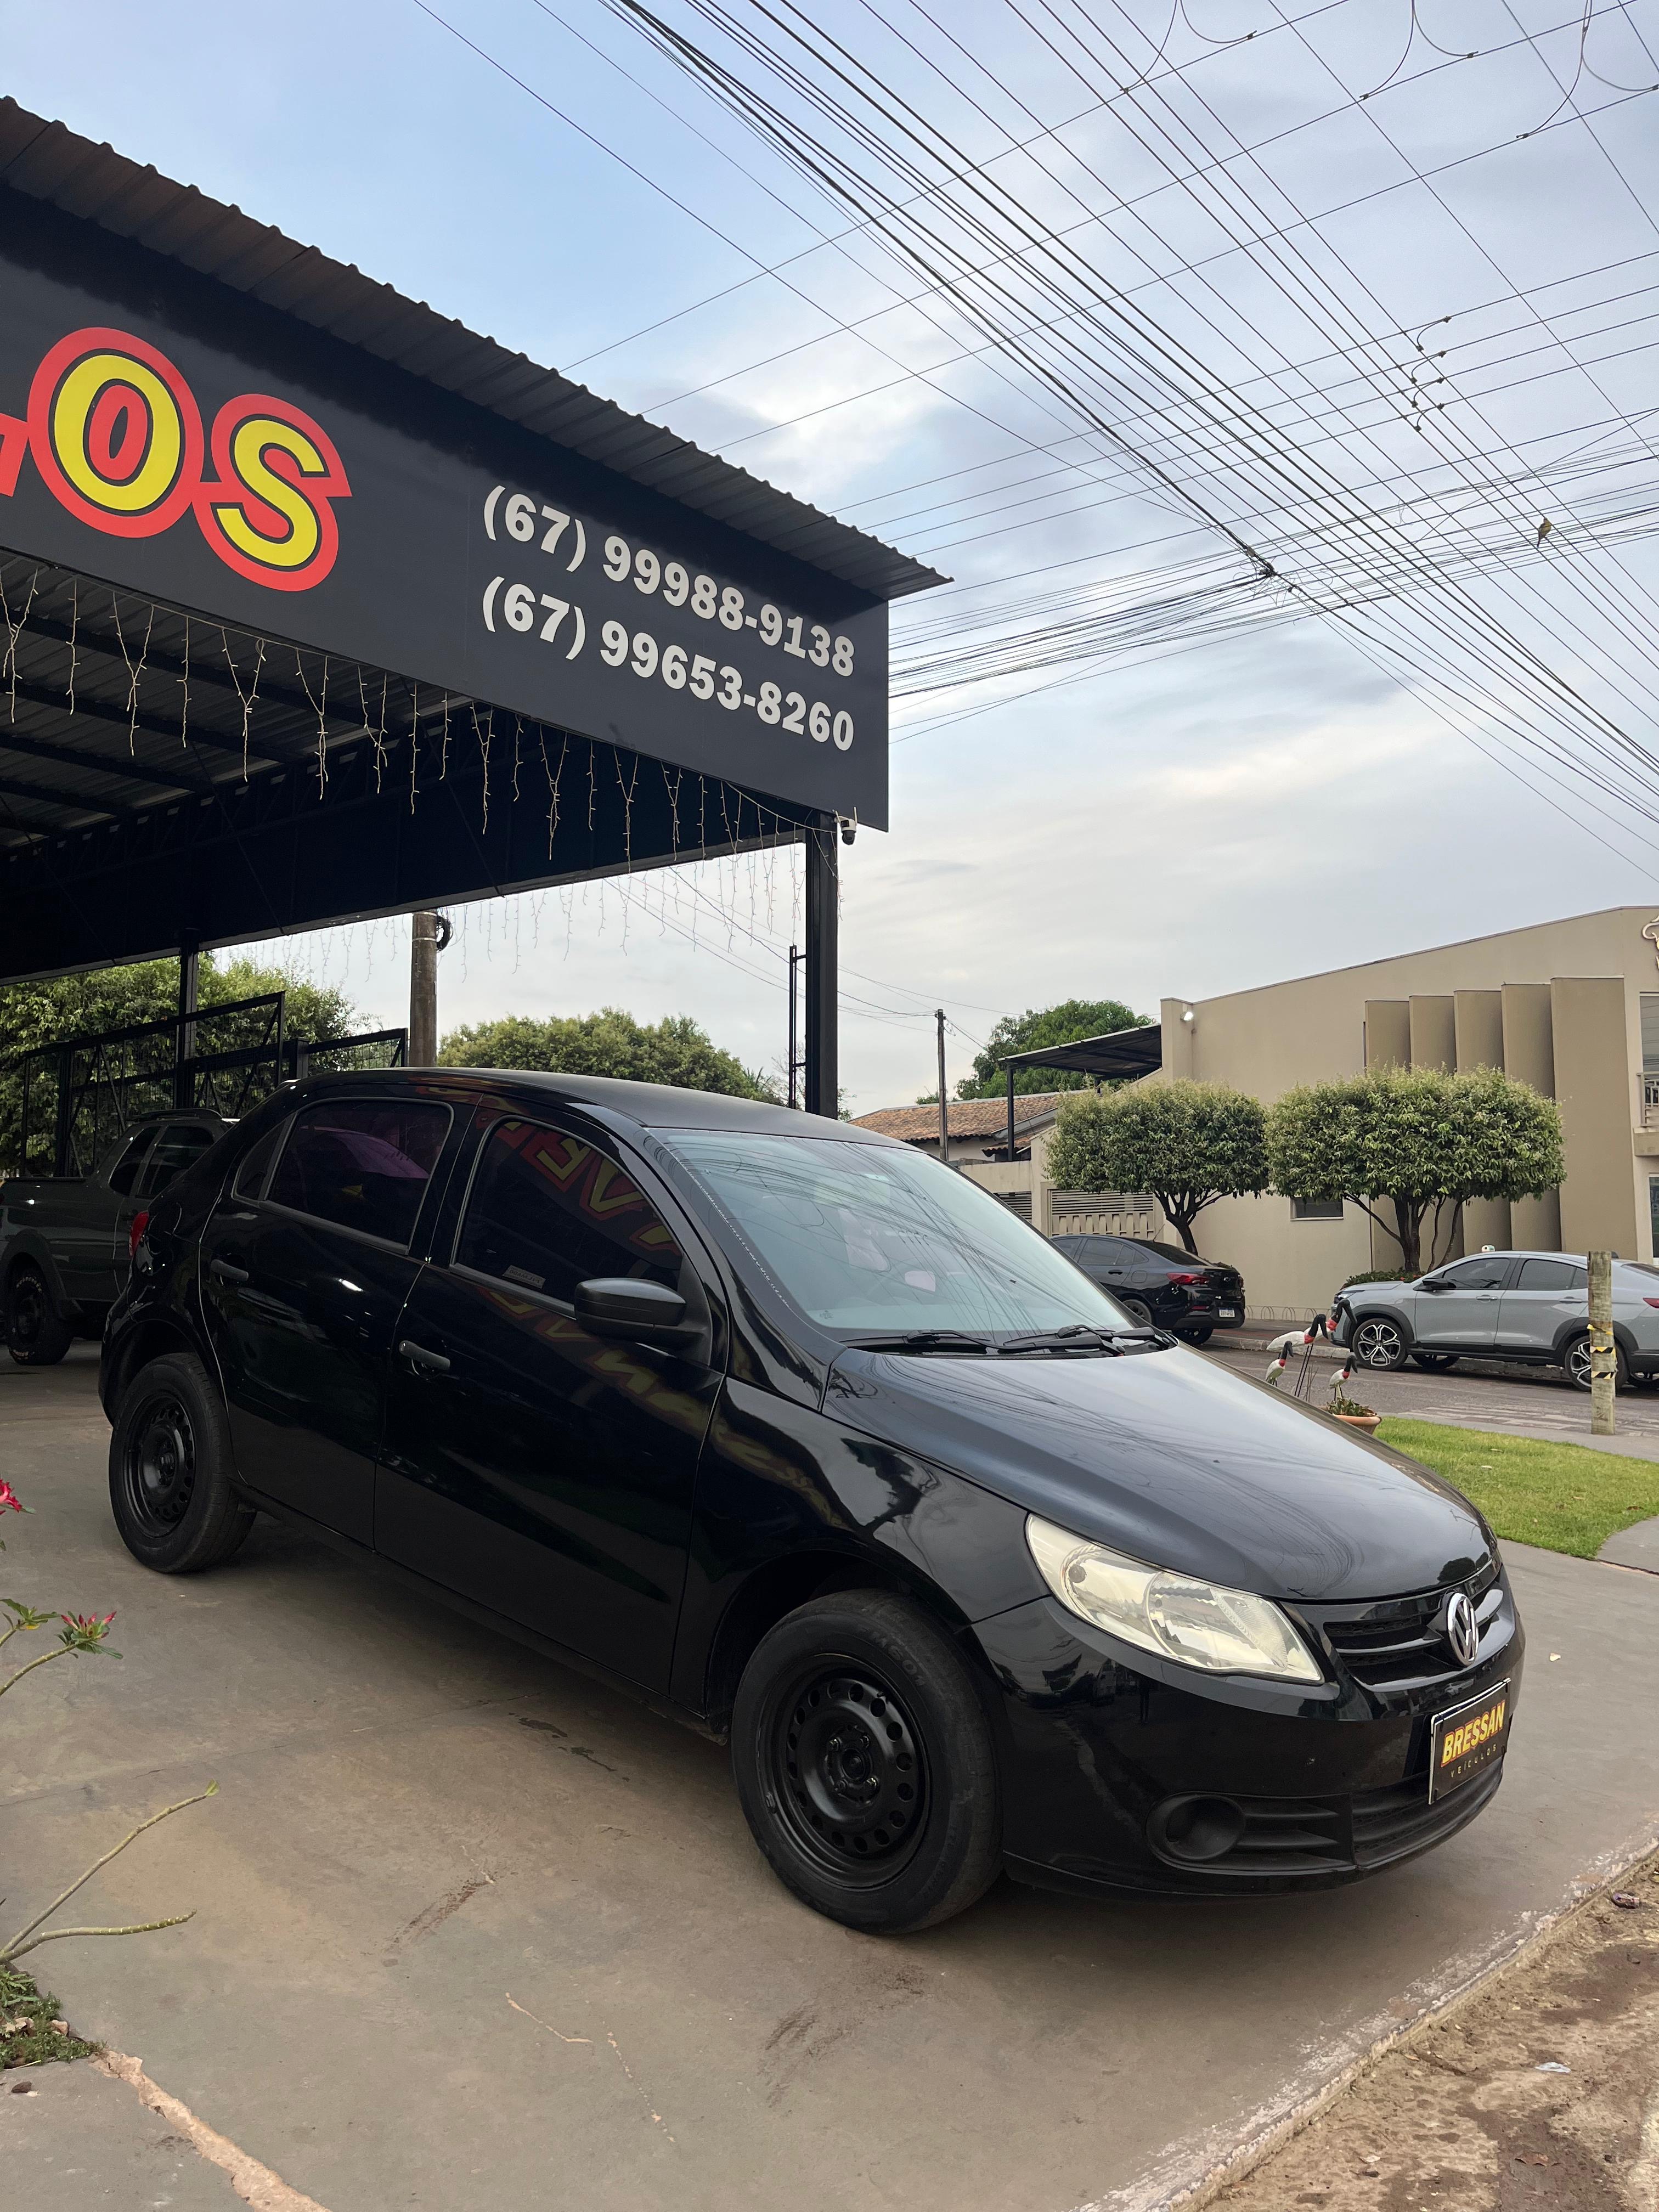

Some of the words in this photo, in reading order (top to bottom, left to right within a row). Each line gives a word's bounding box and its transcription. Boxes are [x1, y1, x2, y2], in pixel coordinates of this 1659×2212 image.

[0, 328, 352, 592] OS
[482, 576, 586, 661] (67)
[600, 620, 854, 751] 99653-8260
[484, 486, 586, 572] (67)
[603, 536, 855, 677] 99988-9138
[1441, 1700, 1505, 1767] BRESSAN
[1451, 1744, 1496, 1778] VEÍCULOS
